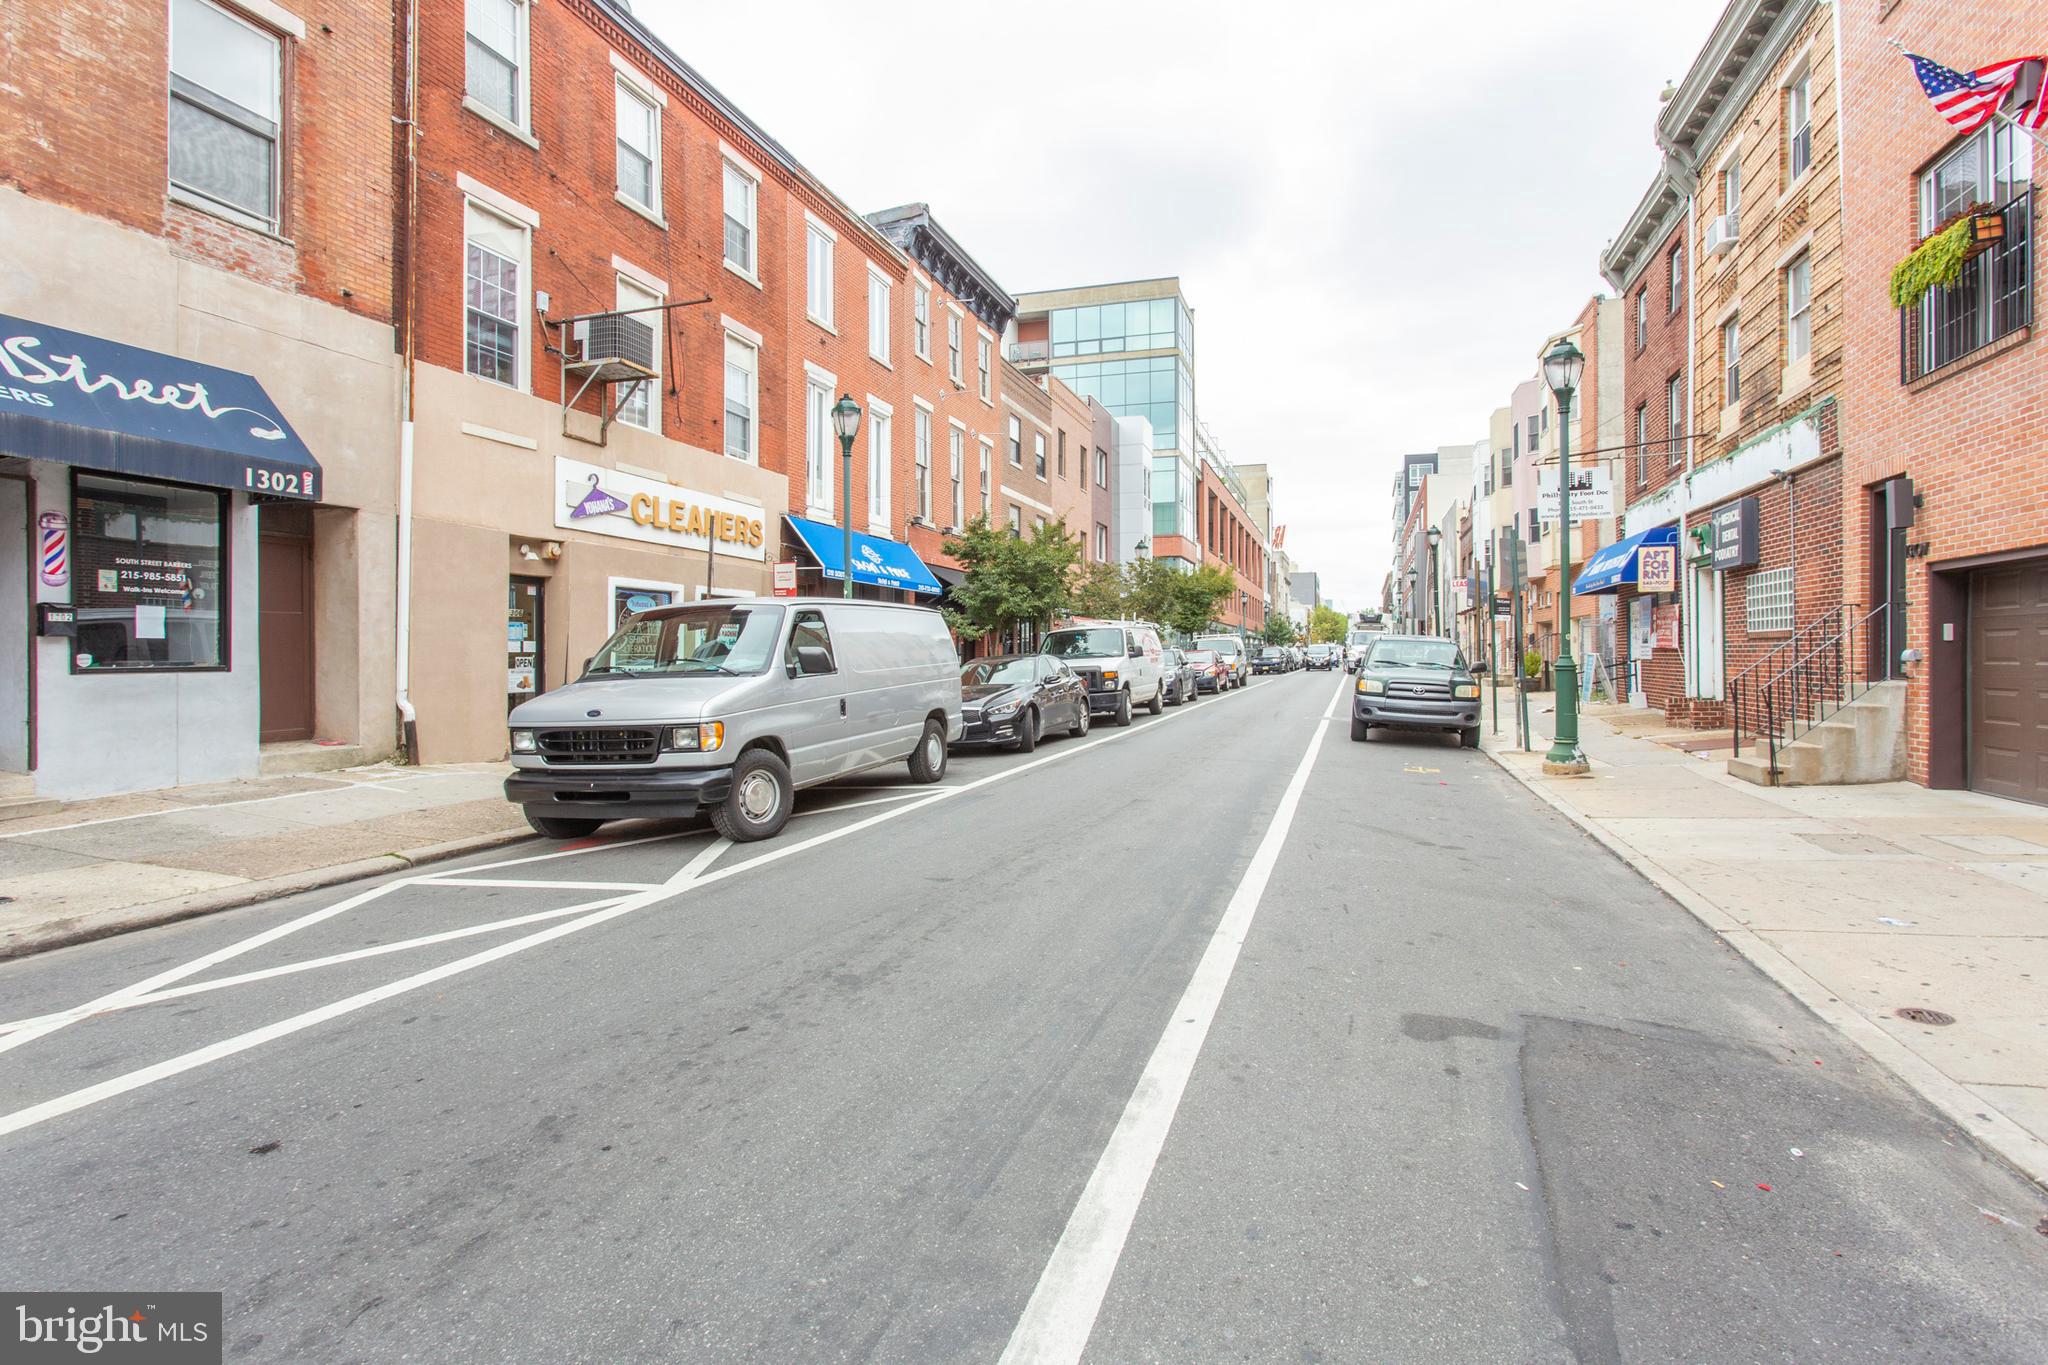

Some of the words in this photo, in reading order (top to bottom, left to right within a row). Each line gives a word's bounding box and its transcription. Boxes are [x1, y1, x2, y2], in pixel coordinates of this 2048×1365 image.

[4, 336, 224, 419] Street
[246, 467, 299, 494] 1302
[631, 492, 764, 548] CLEANERS
[1643, 550, 1669, 560] APT
[115, 557, 139, 565] SOUTH
[140, 559, 162, 567] STREET
[163, 561, 193, 569] BARBERS
[1643, 560, 1669, 570] FOR
[121, 570, 187, 582] 215-985-5851
[1643, 570, 1669, 579] RNT
[516, 658, 532, 668] OPEN
